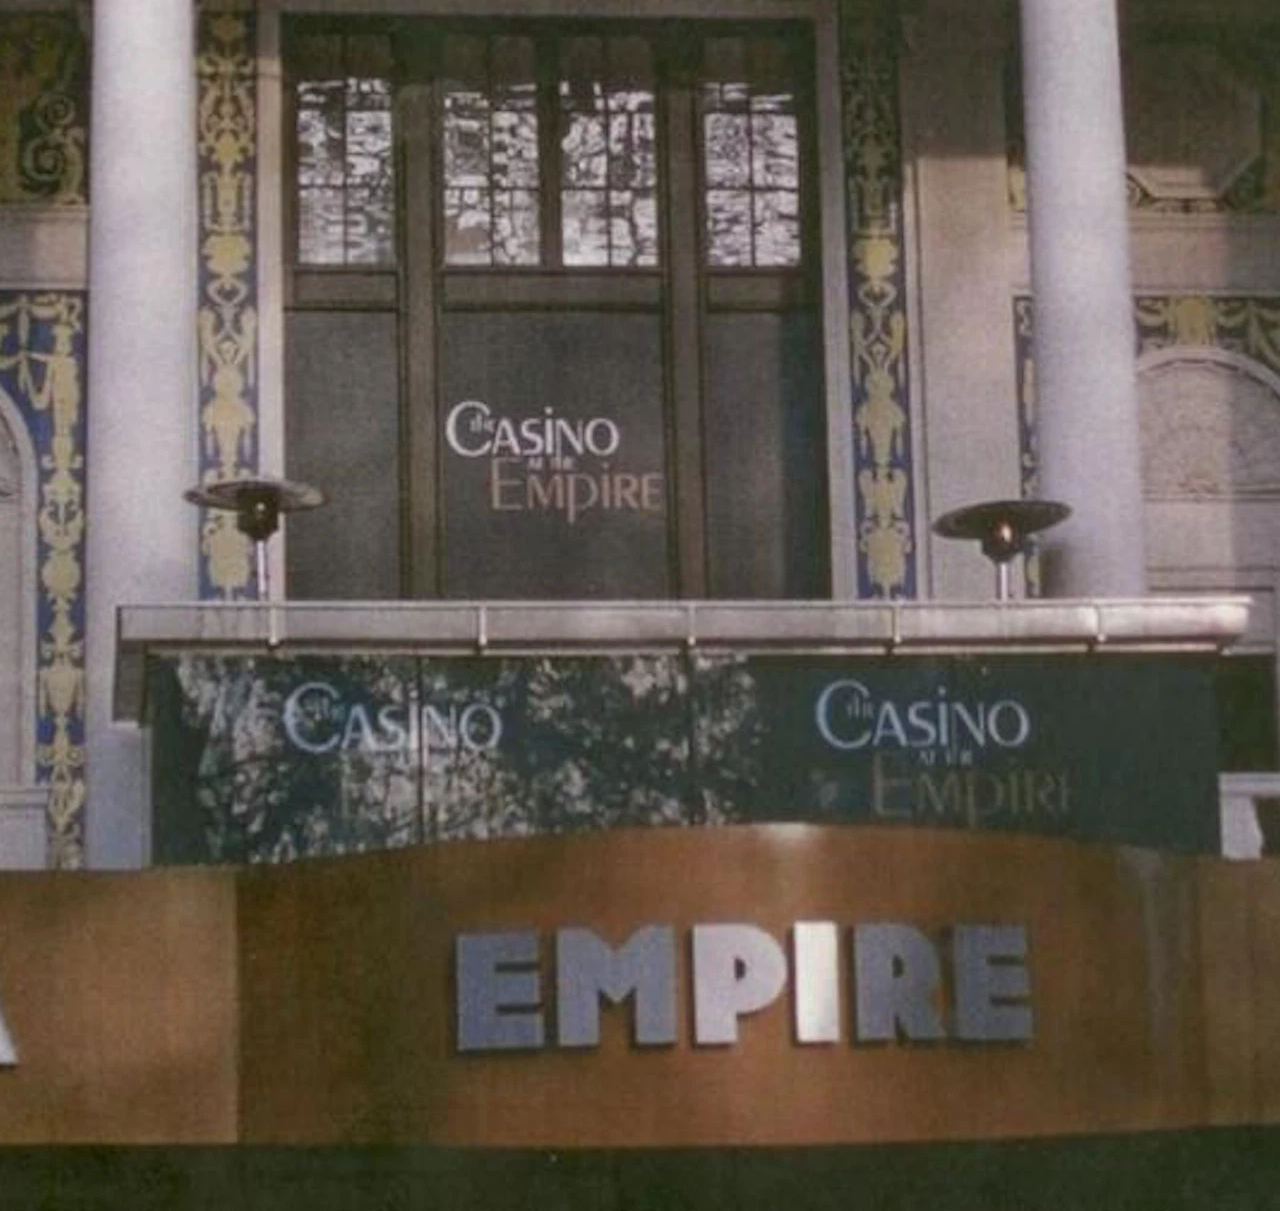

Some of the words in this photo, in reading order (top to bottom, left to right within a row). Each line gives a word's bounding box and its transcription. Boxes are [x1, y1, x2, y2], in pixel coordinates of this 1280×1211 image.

[445, 399, 620, 458] CASINO
[491, 456, 665, 525] EMPIRE
[283, 681, 503, 754] CASINO
[815, 677, 1031, 750] CASINO
[455, 919, 1035, 1053] EMPIRE
